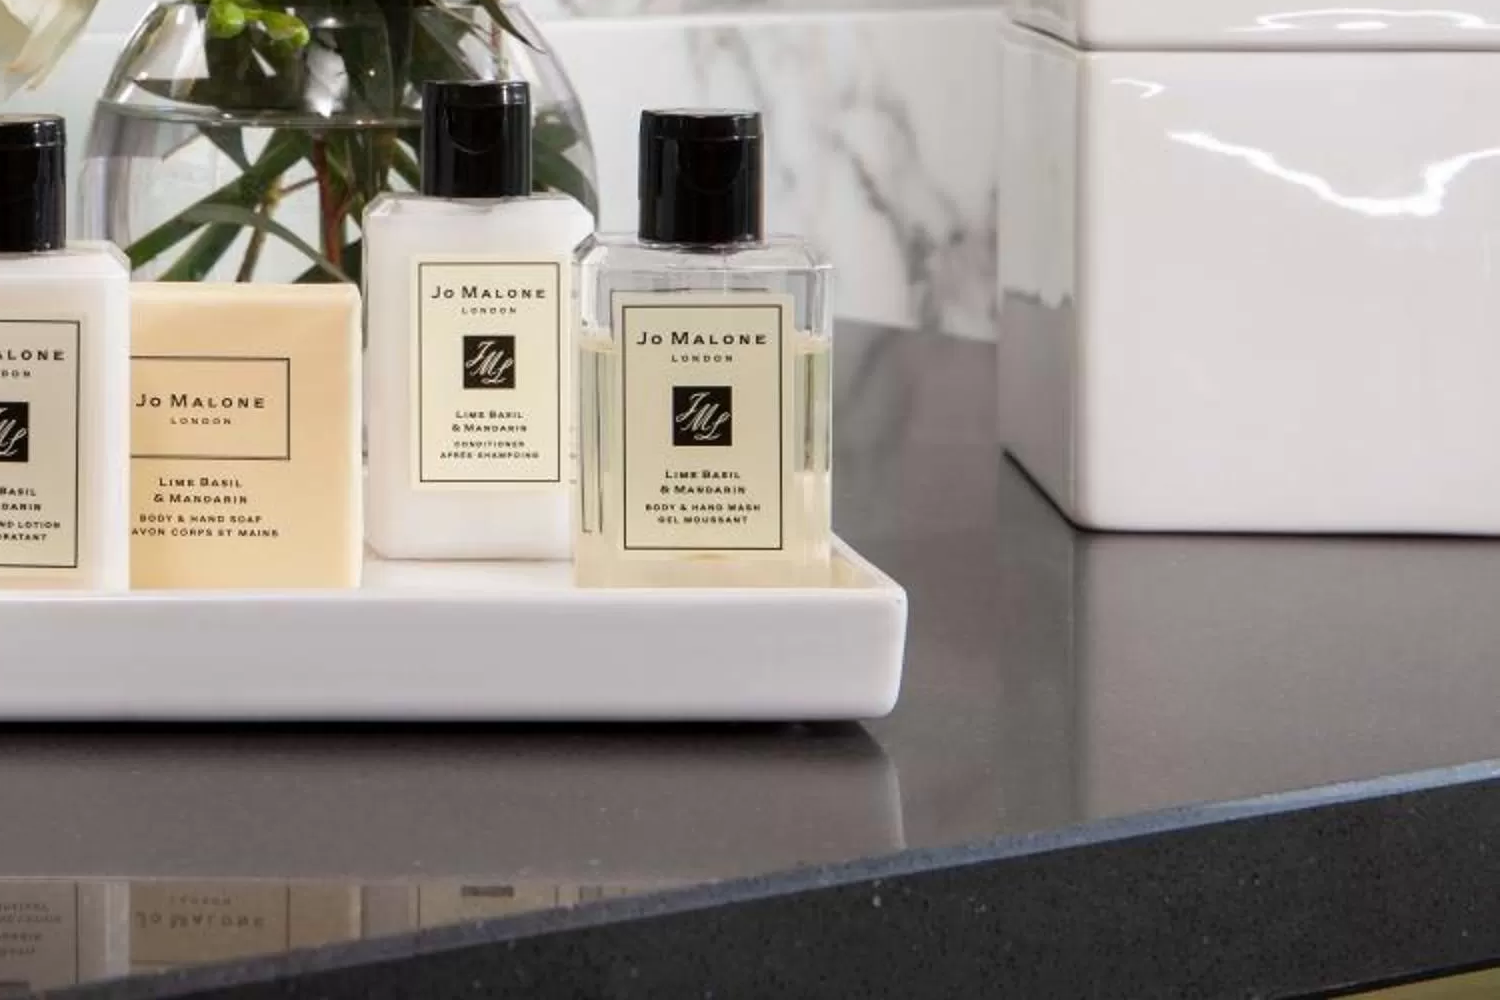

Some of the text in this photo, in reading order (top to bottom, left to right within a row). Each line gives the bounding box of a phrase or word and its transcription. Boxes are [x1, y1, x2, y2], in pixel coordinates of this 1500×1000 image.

[431, 285, 546, 299] JO MALONE
[636, 331, 767, 345] JO MALONE
[671, 354, 733, 363] LONDON
[136, 393, 265, 409] JO MALONE
[455, 410, 524, 420] LIME BASIL
[170, 417, 232, 425] LONDON
[451, 424, 527, 433] & MANDARIN
[665, 469, 740, 480] LIME BASIL
[159, 477, 243, 488] LIME BASIL
[0, 486, 37, 497] BASIL
[660, 485, 746, 495] & MANDARIN
[153, 493, 248, 504] & MANDARIN
[645, 504, 761, 512] BODY & HAND WASH
[139, 514, 263, 523] BODY & HAND SOAP
[657, 516, 748, 525] GEL MOUSSANT
[18, 520, 61, 529] LOTION
[131, 527, 165, 537] AVON
[171, 528, 213, 537] CORPS
[238, 529, 279, 538] MAINS
